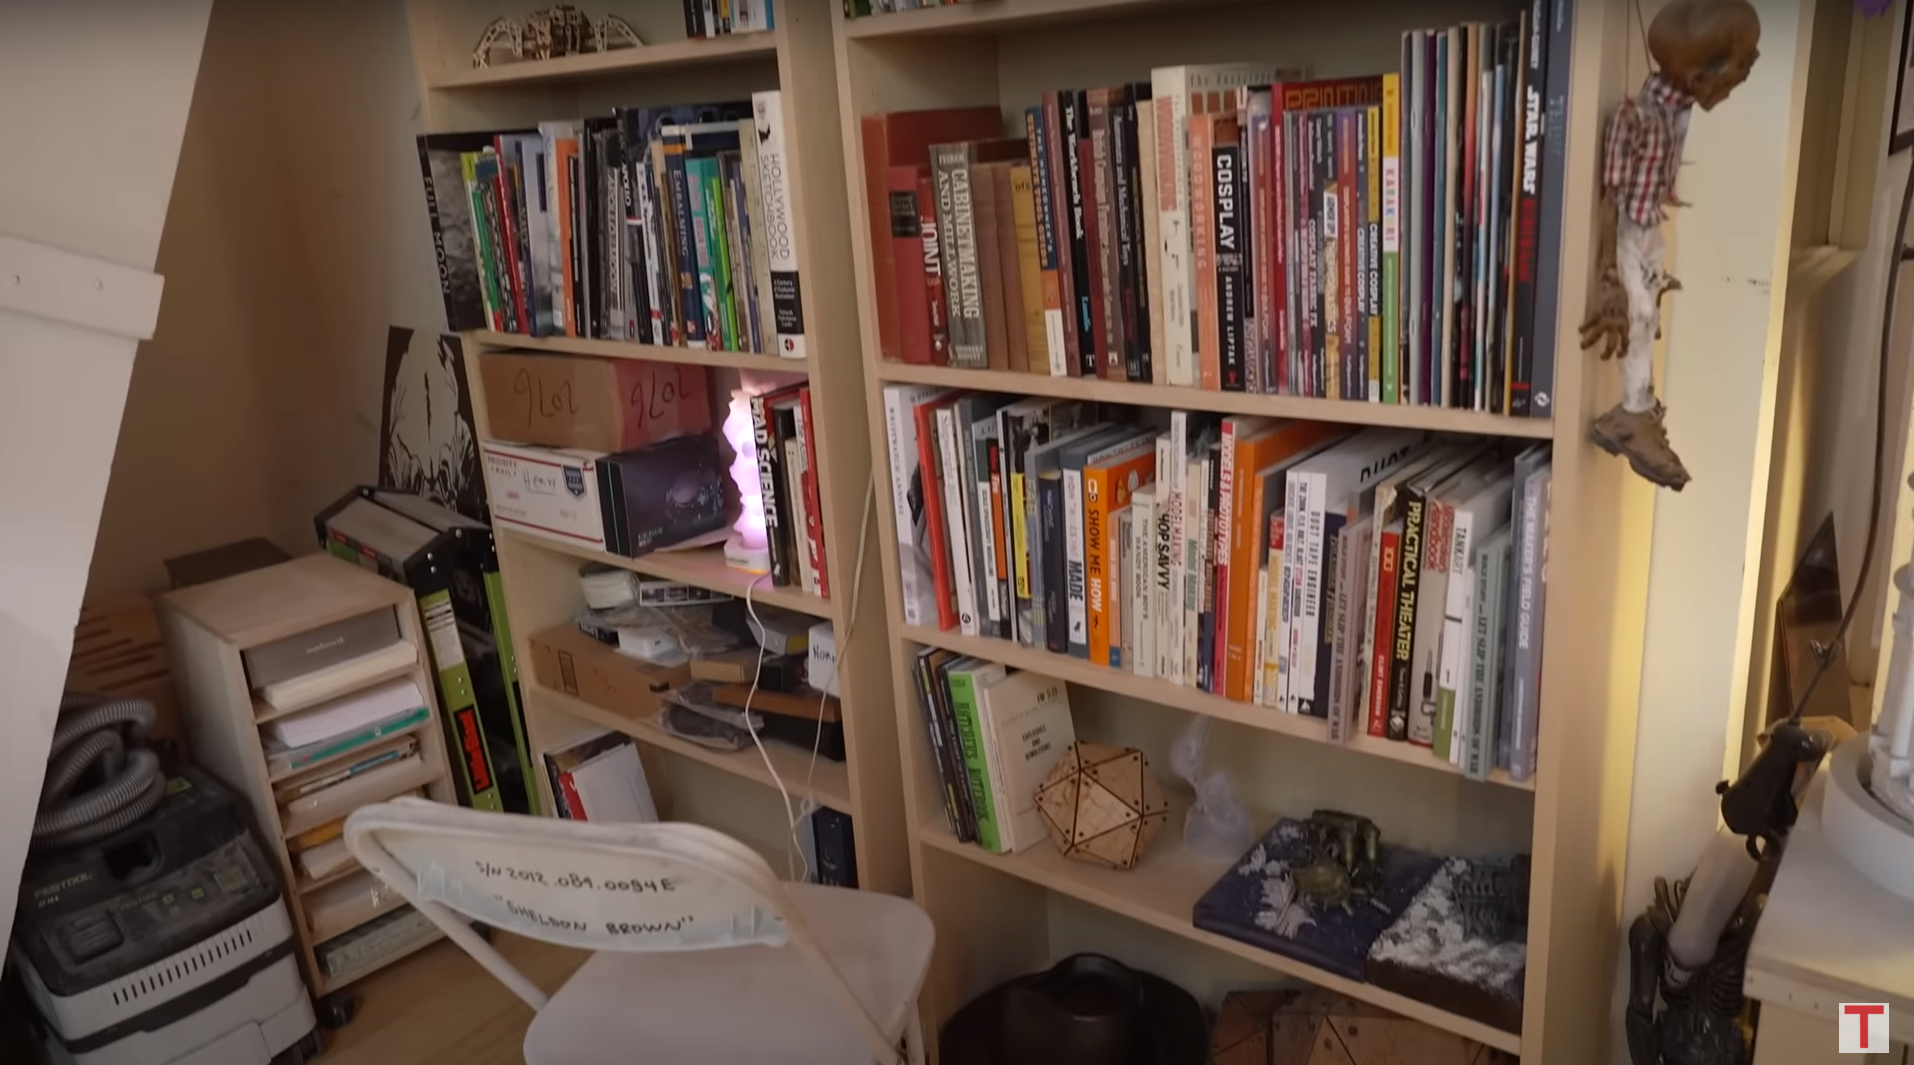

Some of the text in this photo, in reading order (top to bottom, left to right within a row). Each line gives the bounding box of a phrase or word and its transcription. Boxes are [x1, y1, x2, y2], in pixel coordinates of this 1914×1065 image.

[1036, 126, 1045, 152] THE
[1525, 84, 1540, 141] STAR
[620, 162, 633, 207] APOLLO
[1027, 113, 1049, 268] ULTIMATE TOOL GUIDE
[1065, 104, 1084, 240] The Workbench Book
[1116, 165, 1127, 185] and
[1523, 140, 1538, 195] WARS
[672, 169, 689, 258] EMBALMING
[761, 154, 778, 259] SKETCHBOOK
[770, 153, 790, 260] HOLLYWOOD
[1117, 186, 1131, 242] Mechanical
[1192, 136, 1207, 269] WOODWORKING
[1216, 153, 1235, 250] COSPLAY
[423, 176, 450, 294] FULL MOON
[920, 215, 941, 277] JOINT
[938, 169, 961, 318] AND MILLWORK
[951, 168, 980, 318] CABINETMAKING
[1121, 243, 1132, 267] Toys
[1308, 218, 1317, 268] COSPLAY
[1325, 240, 1338, 334] THERMOPLASTICS
[1357, 227, 1366, 313] CREATIVE COSPLAY
[1368, 223, 1379, 316] CREATIVE COSPLAY
[1224, 275, 1236, 366] ANDREW LIPTAK
[1310, 311, 1318, 327] FX
[750, 397, 779, 529] MAD SCIENCE
[1217, 430, 1234, 567] MODELS & PROTOTYPES
[1157, 513, 1170, 591] HOP SAVVY
[1170, 490, 1183, 567] MODELMAKING
[1452, 526, 1467, 575] TANKART
[1068, 559, 1083, 601] MADE
[1087, 508, 1102, 614] SHOW ME HOW
[1186, 538, 1198, 612] Model Making
[1306, 510, 1321, 617] DUCT TAPE ENGINEER
[1383, 546, 1394, 572] 100
[1396, 500, 1423, 661] PRACTICAL THEATER
[1518, 495, 1538, 649] THE MAKER'S FIELD GUIDE
[1337, 612, 1347, 635] SLIP
[1339, 592, 1348, 611] LET
[1477, 616, 1488, 636] LET
[1336, 636, 1345, 657] THE
[1377, 654, 1385, 678] CLINT
[1475, 663, 1485, 684] THE
[1476, 637, 1487, 661] SLIP
[1021, 723, 1047, 743] EXPLOSIVES
[1331, 720, 1340, 739] WAR
[1332, 705, 1341, 719] OF
[1024, 742, 1052, 762] DEMOLITIONS
[1031, 737, 1041, 748] AND
[1469, 751, 1480, 774] WAR
[1471, 736, 1481, 750] OF
[474, 860, 502, 878] S/N
